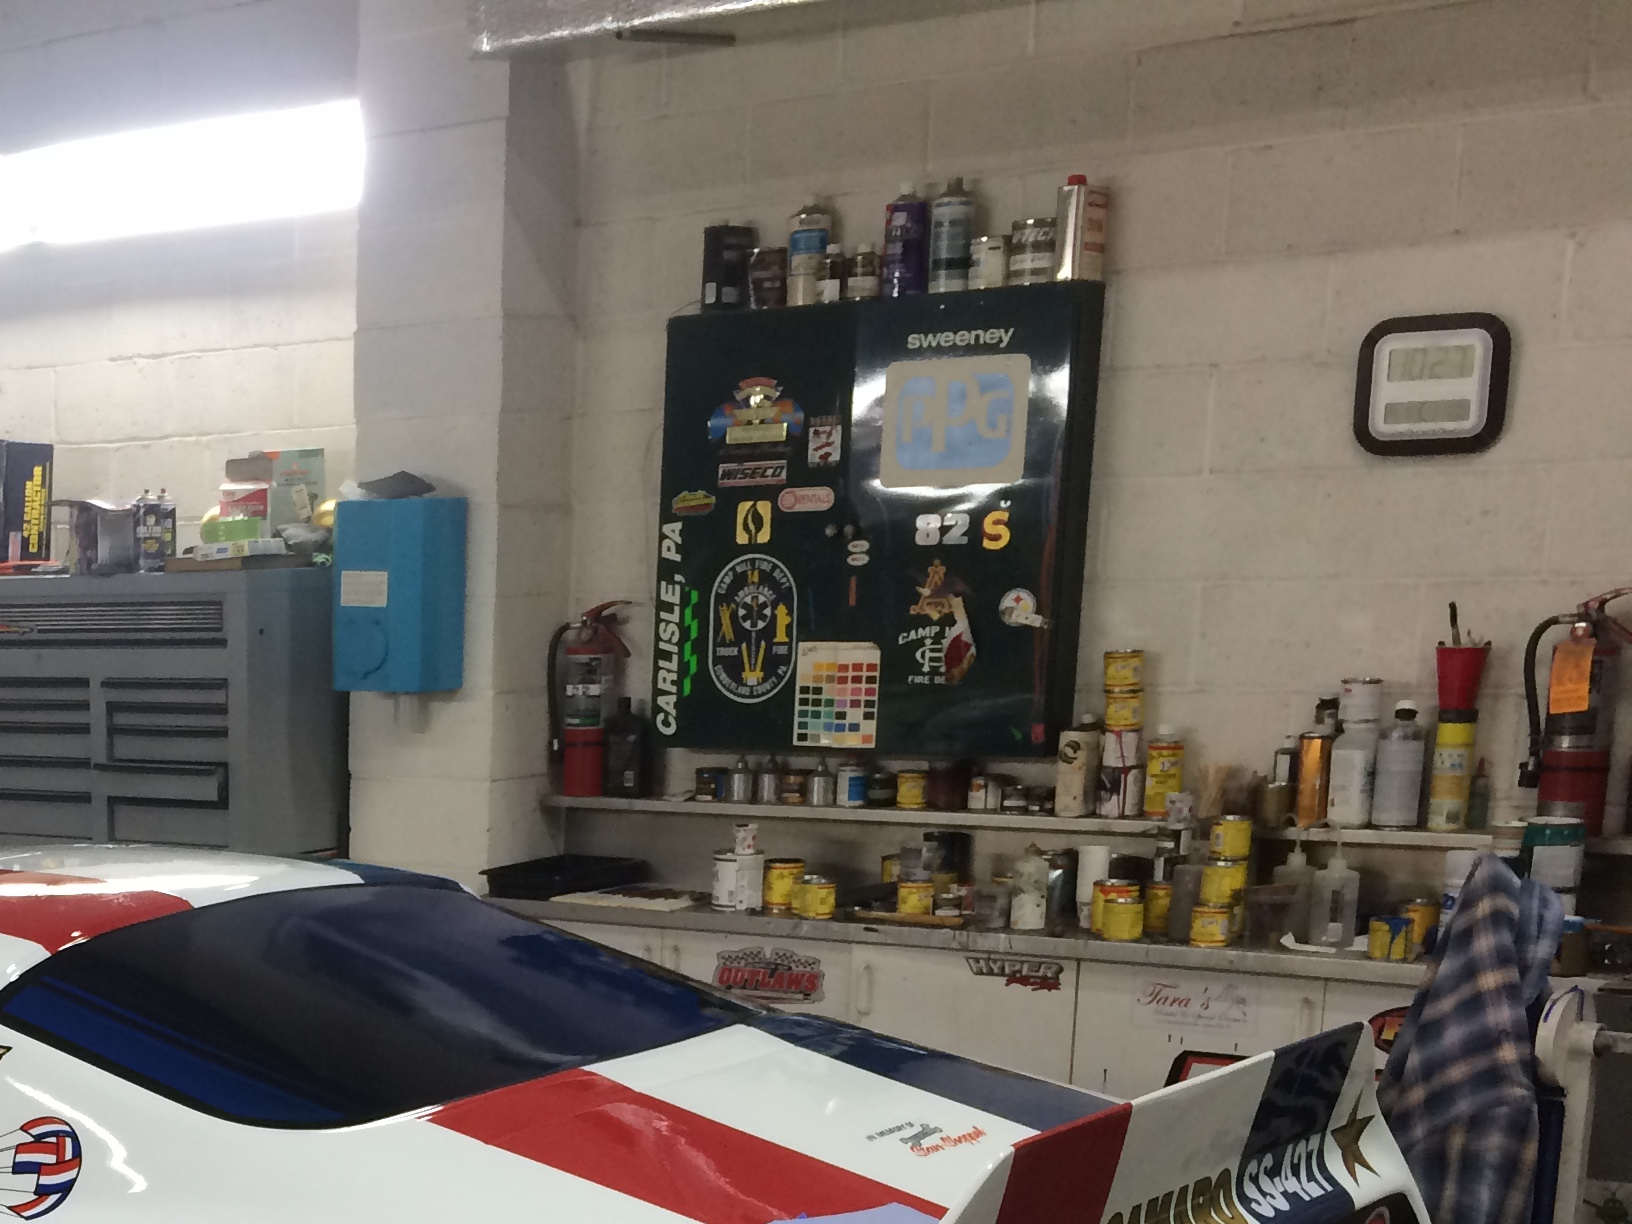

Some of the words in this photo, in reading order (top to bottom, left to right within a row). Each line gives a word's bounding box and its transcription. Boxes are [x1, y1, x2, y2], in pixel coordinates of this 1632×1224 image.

[907, 327, 1014, 349] sweeney
[719, 465, 785, 481] WISECO
[29, 465, 43, 553] CONTRACTOR
[661, 521, 684, 563] PA
[915, 513, 970, 545] 82
[898, 625, 941, 645] CAMP
[656, 574, 686, 735] CARLISLE,
[908, 676, 930, 685] FIRE
[718, 966, 820, 993] OUTLAWS
[968, 958, 1062, 978] HYPER
[1241, 1133, 1332, 1218] SS-427
